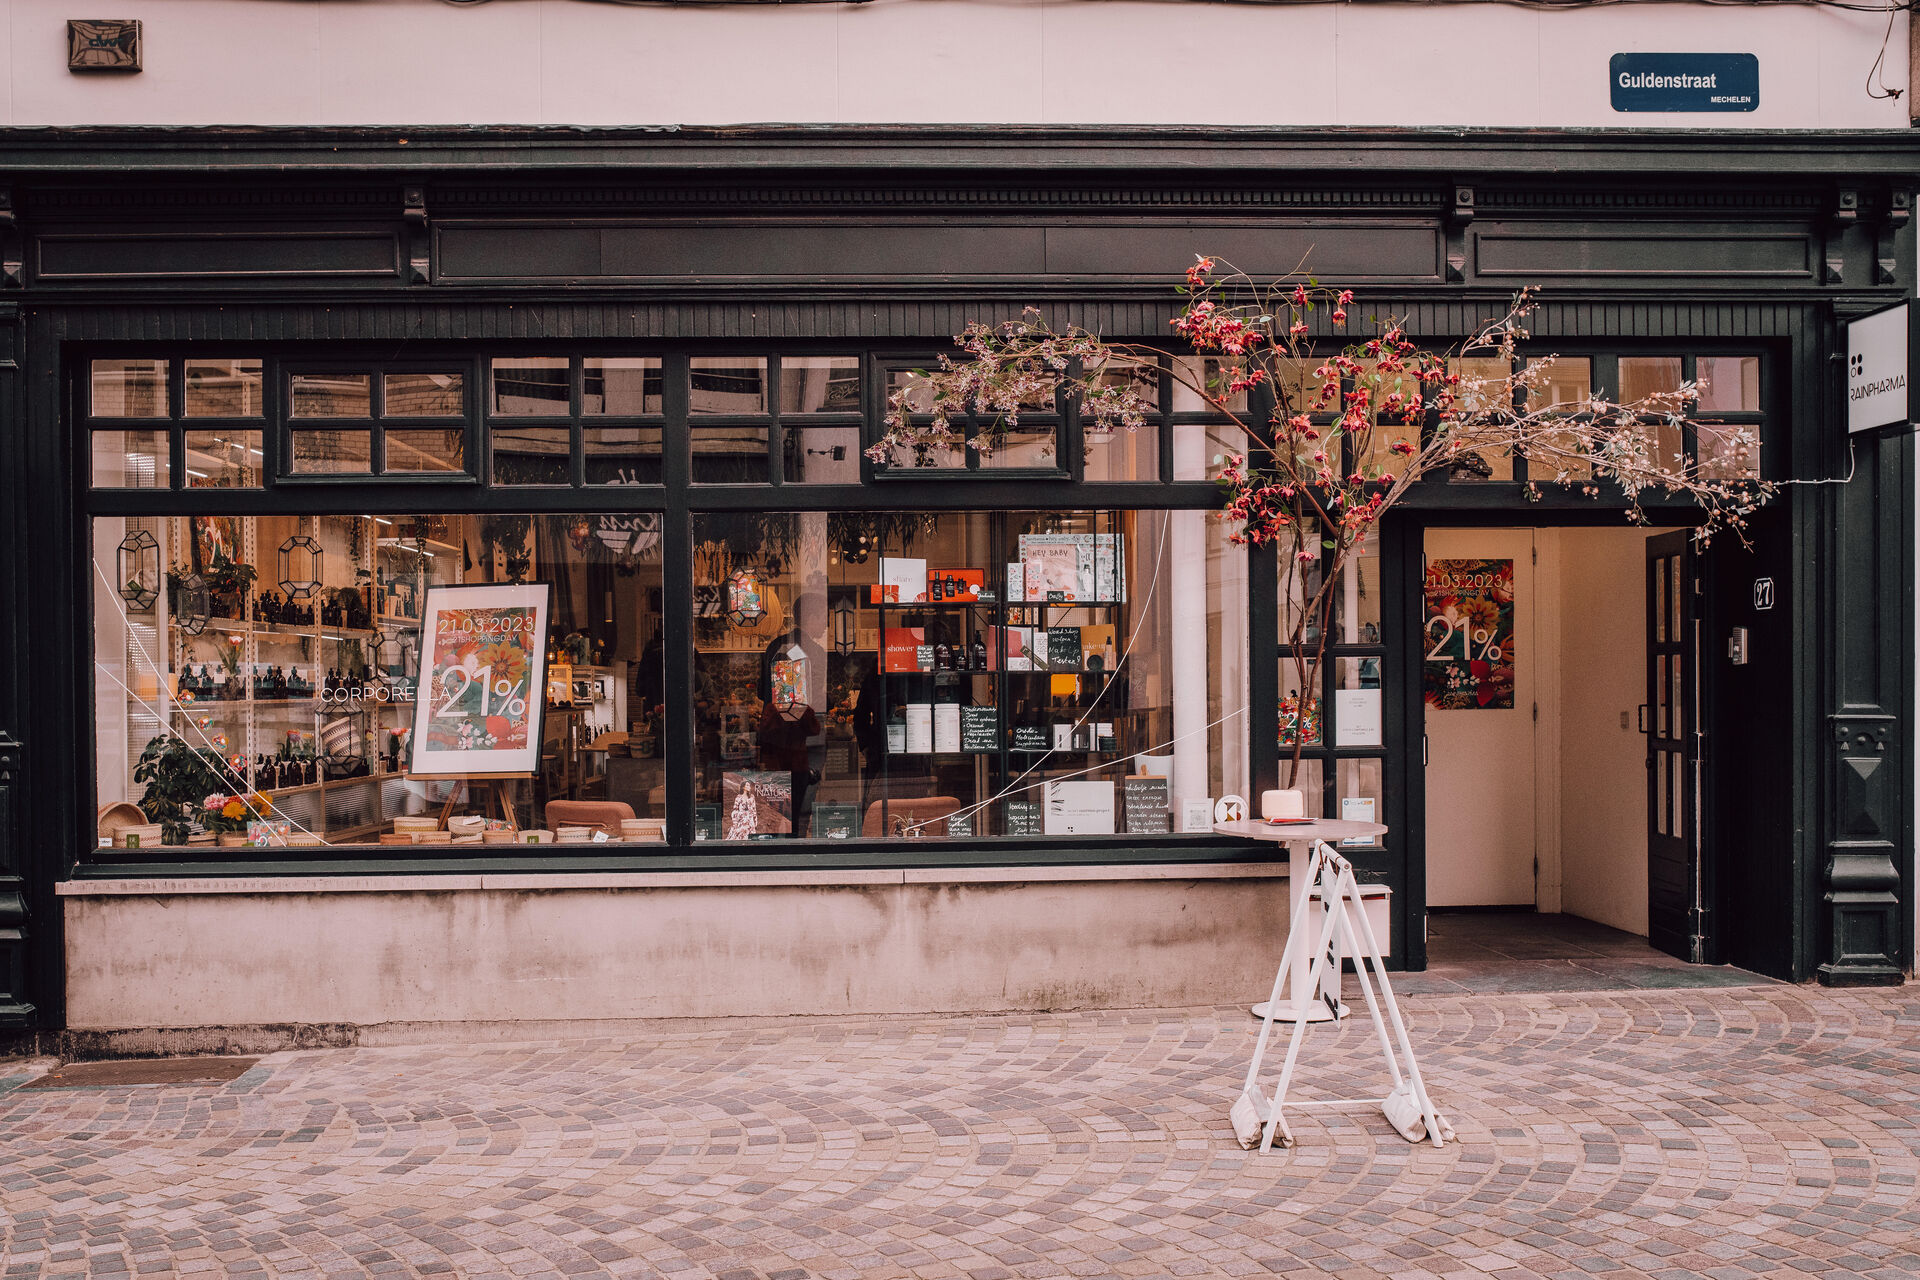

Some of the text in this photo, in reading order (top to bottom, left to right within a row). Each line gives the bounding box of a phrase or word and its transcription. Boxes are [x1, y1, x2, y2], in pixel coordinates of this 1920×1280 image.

[1618, 72, 1717, 88] Guldenstraat
[1850, 374, 1906, 402] RAINPHARMA
[1757, 582, 1770, 606] 27
[437, 616, 535, 635] 21.03.2023
[1426, 615, 1502, 661] 21%
[887, 644, 914, 652] shower
[436, 664, 526, 718] 21%
[1286, 712, 1312, 728] 2%
[756, 788, 791, 797] NATURE
